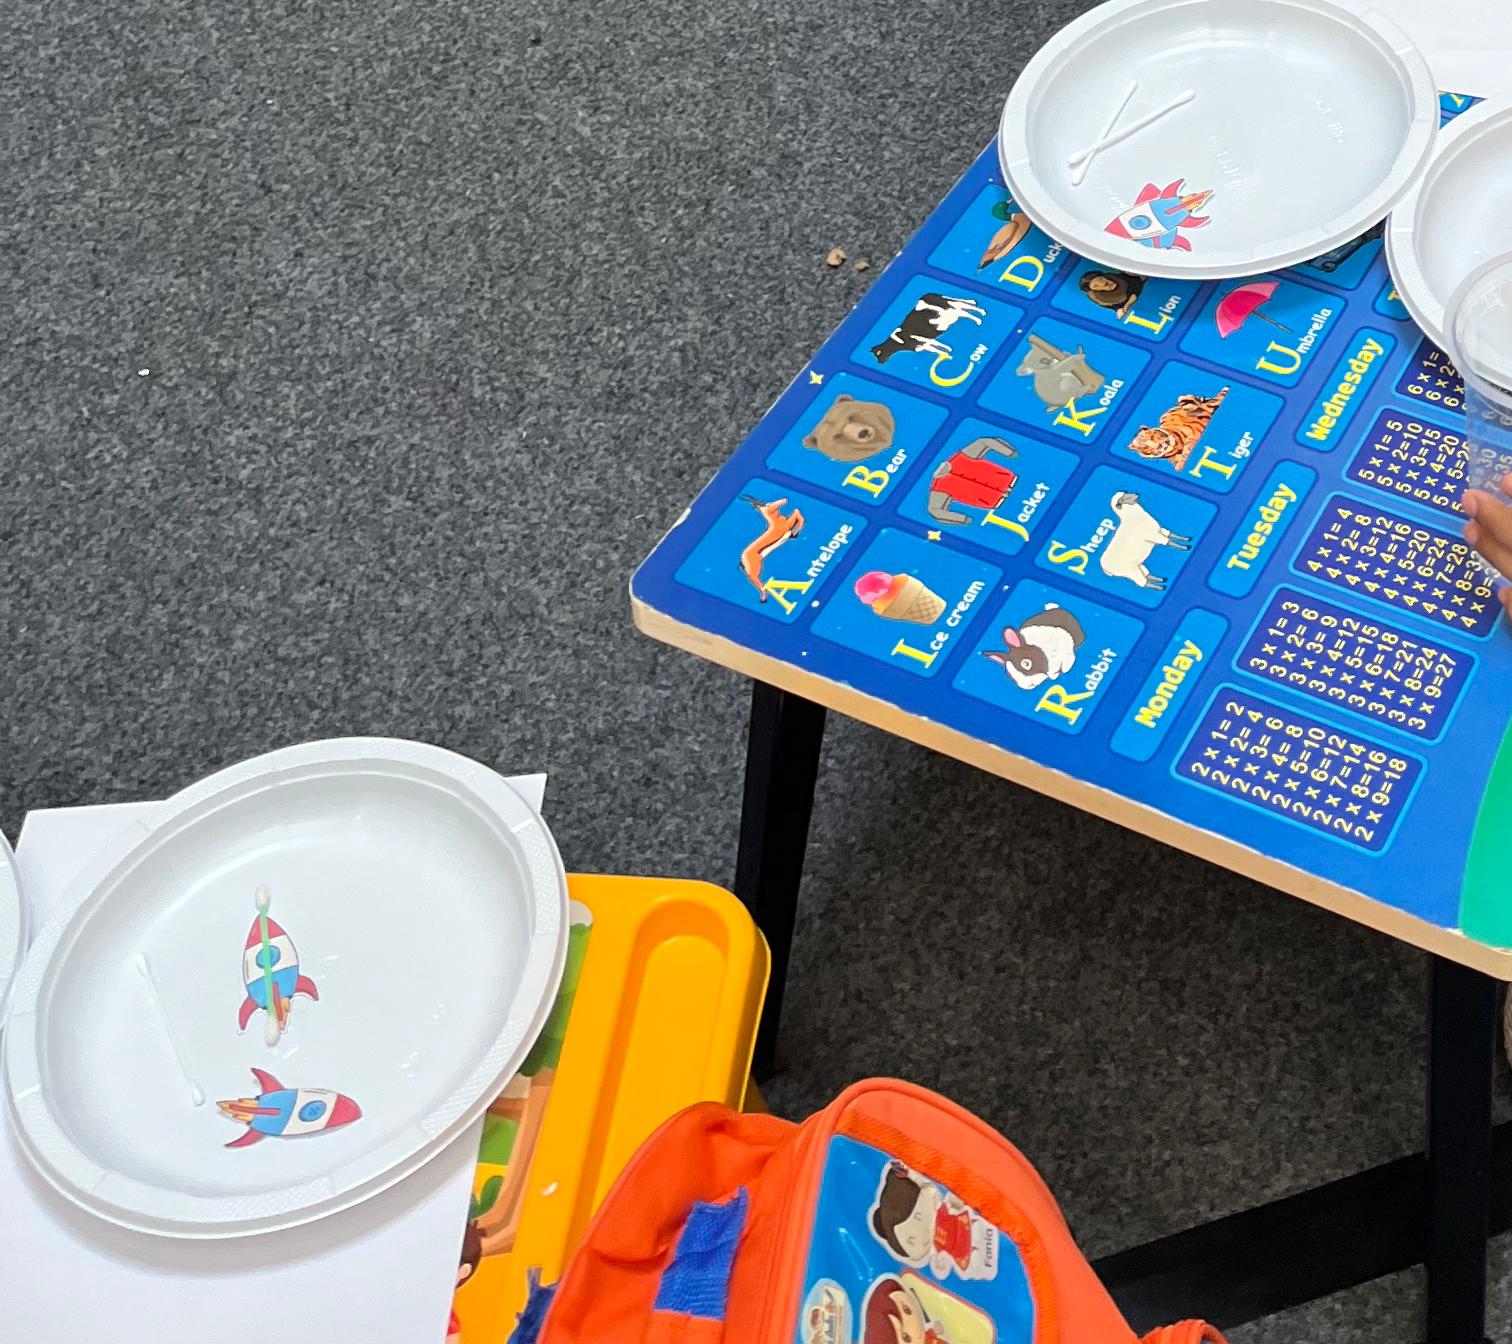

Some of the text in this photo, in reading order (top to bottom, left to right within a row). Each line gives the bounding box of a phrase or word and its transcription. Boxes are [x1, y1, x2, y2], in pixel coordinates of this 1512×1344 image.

[1123, 294, 1182, 335] Lion
[1255, 306, 1333, 376] Umbrella
[929, 343, 989, 388] Cow
[1305, 336, 1385, 442] Wednesday
[1052, 378, 1126, 438] Koala
[841, 448, 908, 499] Bear
[1188, 431, 1255, 481] Tiger
[980, 482, 1051, 543] Jacket
[1046, 517, 1118, 576] Sheep
[1226, 482, 1298, 572] Tuesday
[1307, 508, 1354, 572] 4 x 1= 4
[762, 523, 854, 615] Antelope
[891, 579, 986, 669] Ice cream
[1249, 601, 1300, 671] 3 x 1= 3
[1269, 608, 1319, 678] 3 x 2= 6
[1289, 615, 1338, 685] 3 x 3= 9
[1308, 617, 1361, 693] 3 x 4=12
[1327, 624, 1380, 700] 3 x 5=15
[1034, 647, 1119, 726] Rabbit
[1133, 639, 1204, 729] Monday
[1347, 632, 1399, 708] 3 x 6=18
[1367, 640, 1418, 715] 3 x 7=21
[1387, 647, 1438, 723] 3 x 8=24
[1407, 653, 1457, 730] 3 x 9=27
[1191, 701, 1245, 777] 2 x 1= 2
[1211, 710, 1264, 785] 2 x 2= 4
[1231, 716, 1284, 793] 2 x 3= 6
[1251, 724, 1304, 801] 2 x 4= 8
[1271, 727, 1327, 809] 2 x 5=10
[1291, 734, 1347, 817] 2 x 6=12
[1312, 743, 1367, 825] 2 x 7=14
[1333, 750, 1387, 834] 2 x 8=16
[1354, 758, 1407, 842] 2 x 9=18
[983, 1226, 995, 1269] Fania
